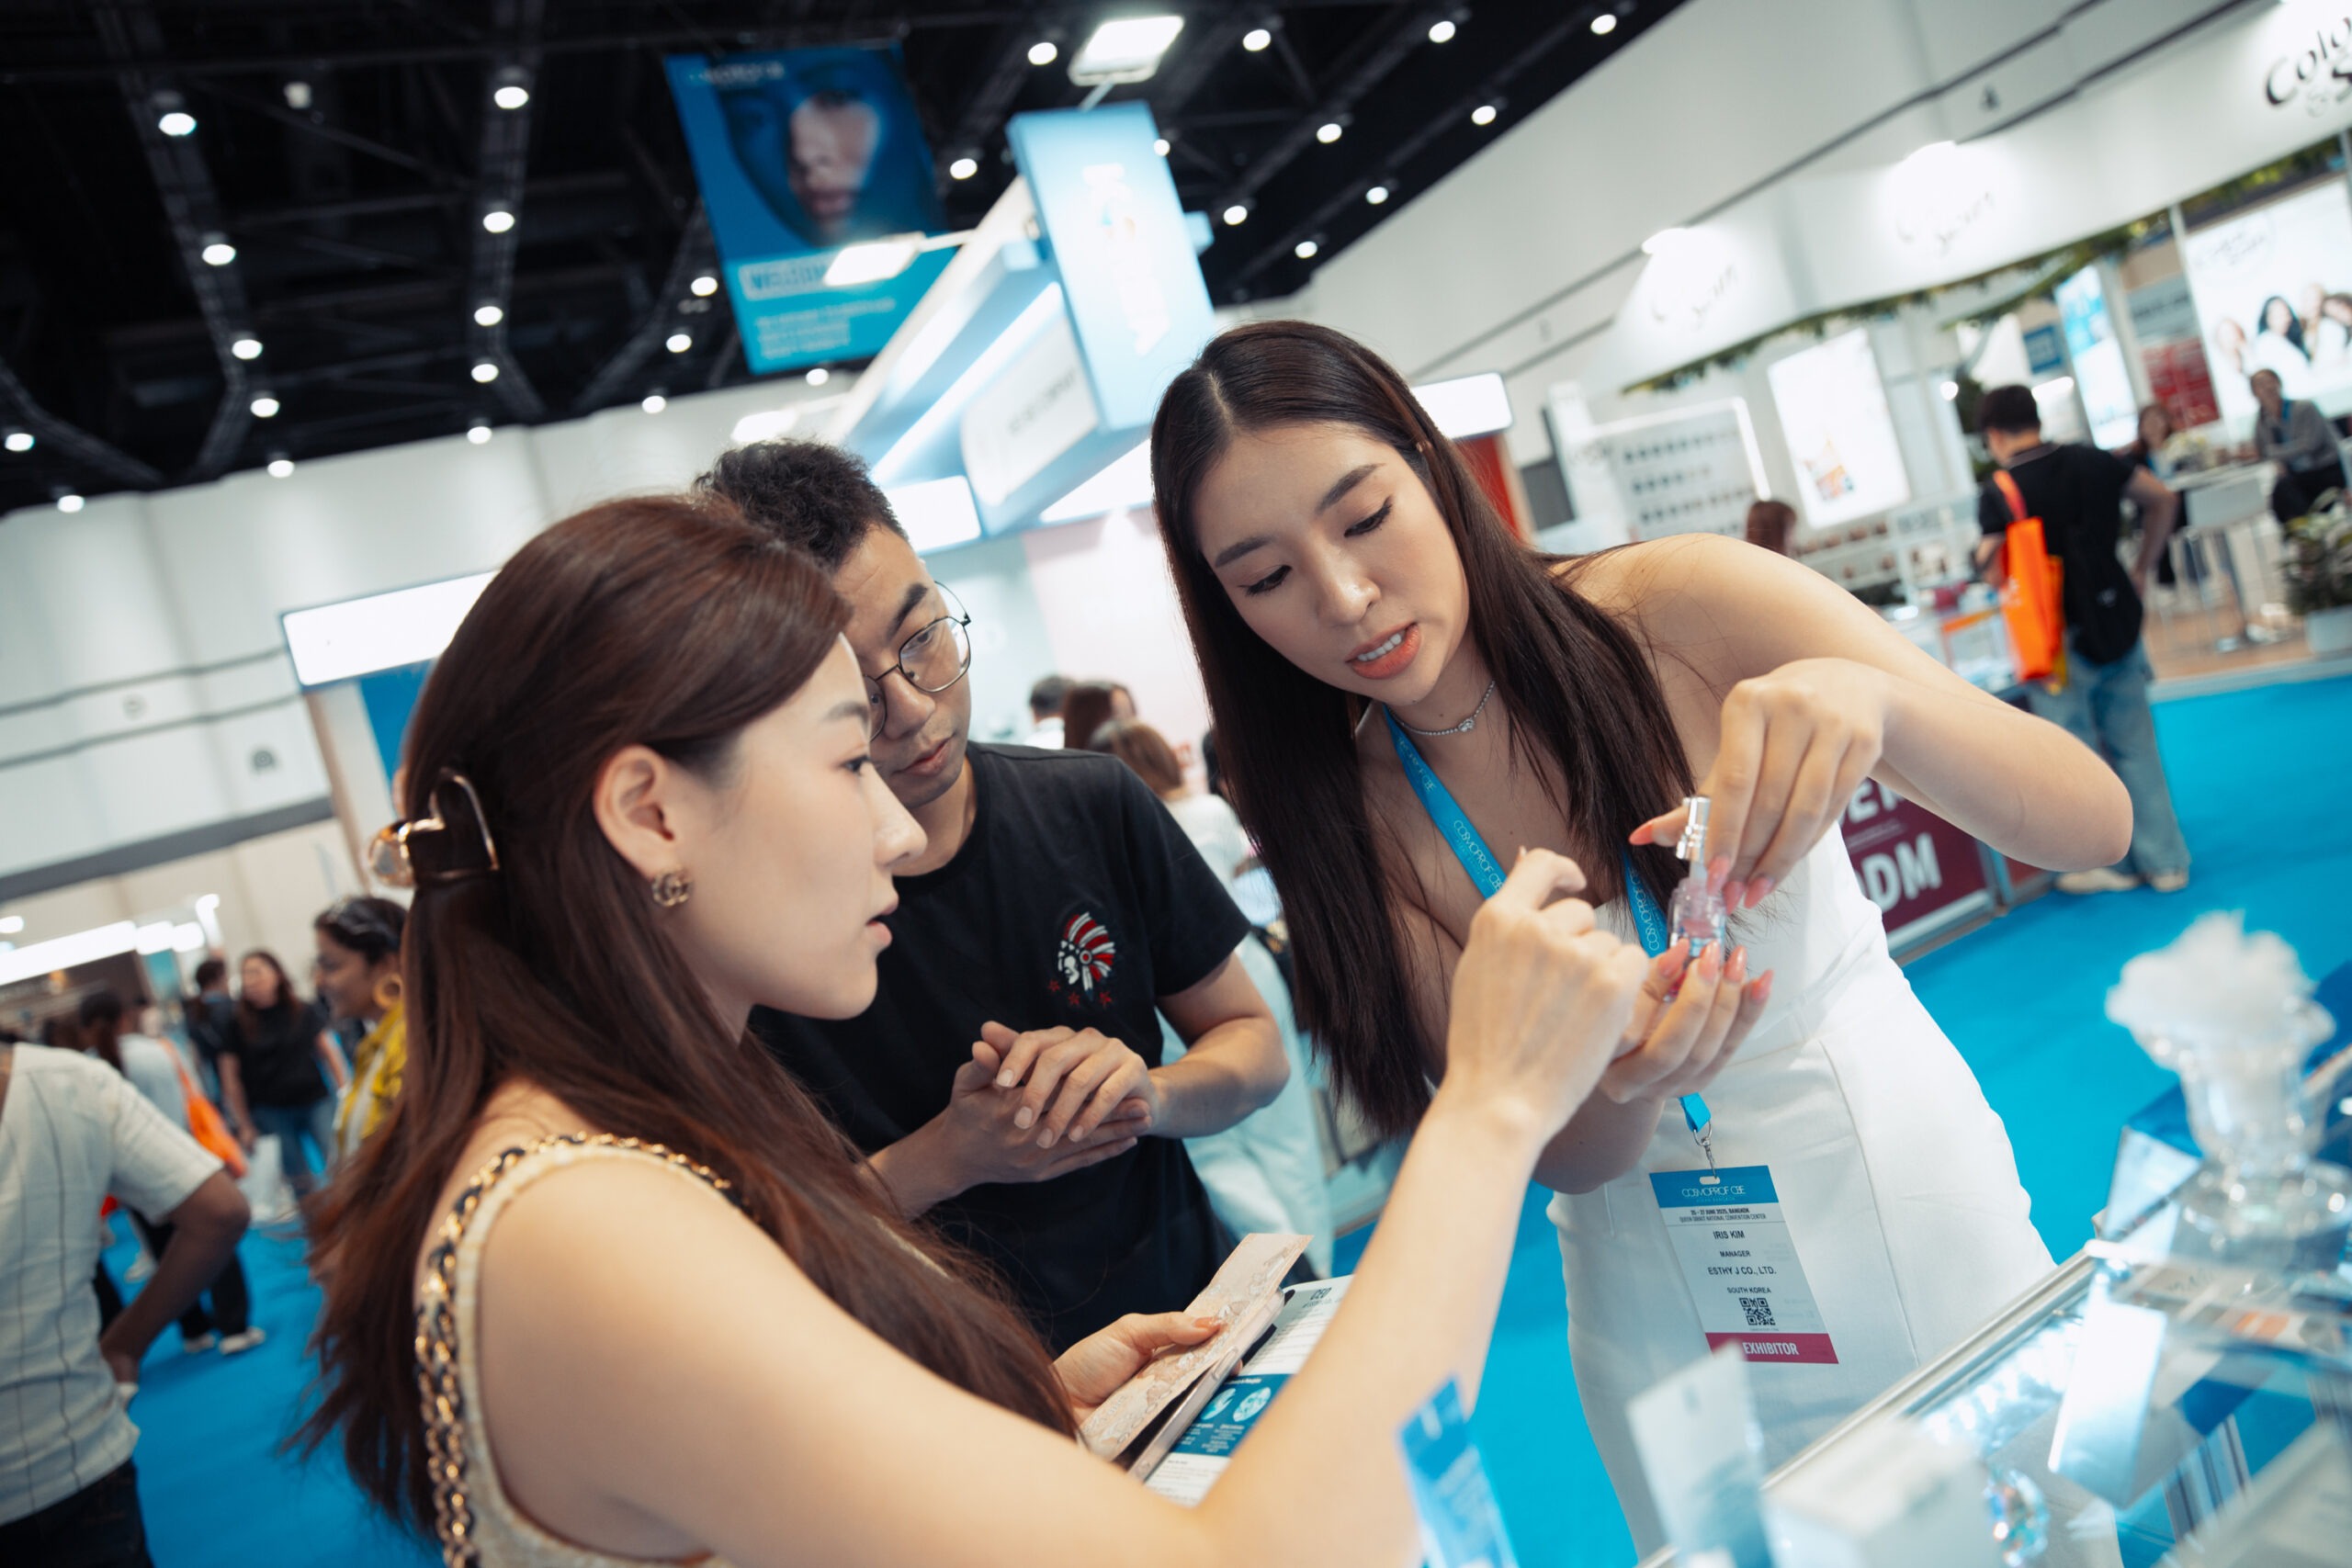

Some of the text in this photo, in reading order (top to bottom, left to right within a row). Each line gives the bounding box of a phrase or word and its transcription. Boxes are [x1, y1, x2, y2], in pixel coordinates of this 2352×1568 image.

[1453, 819, 1494, 873] COSMOPROF
[1855, 831, 1943, 913] DM
[1633, 886, 1660, 951] COSMOPROF
[1681, 1186, 1729, 1198] COSMOPROF
[1713, 1230, 1746, 1239] IRIS KIM
[1707, 1266, 1777, 1276] ESTHY J CO., LTD.
[1742, 1342, 1800, 1356] EXHIBITOR
